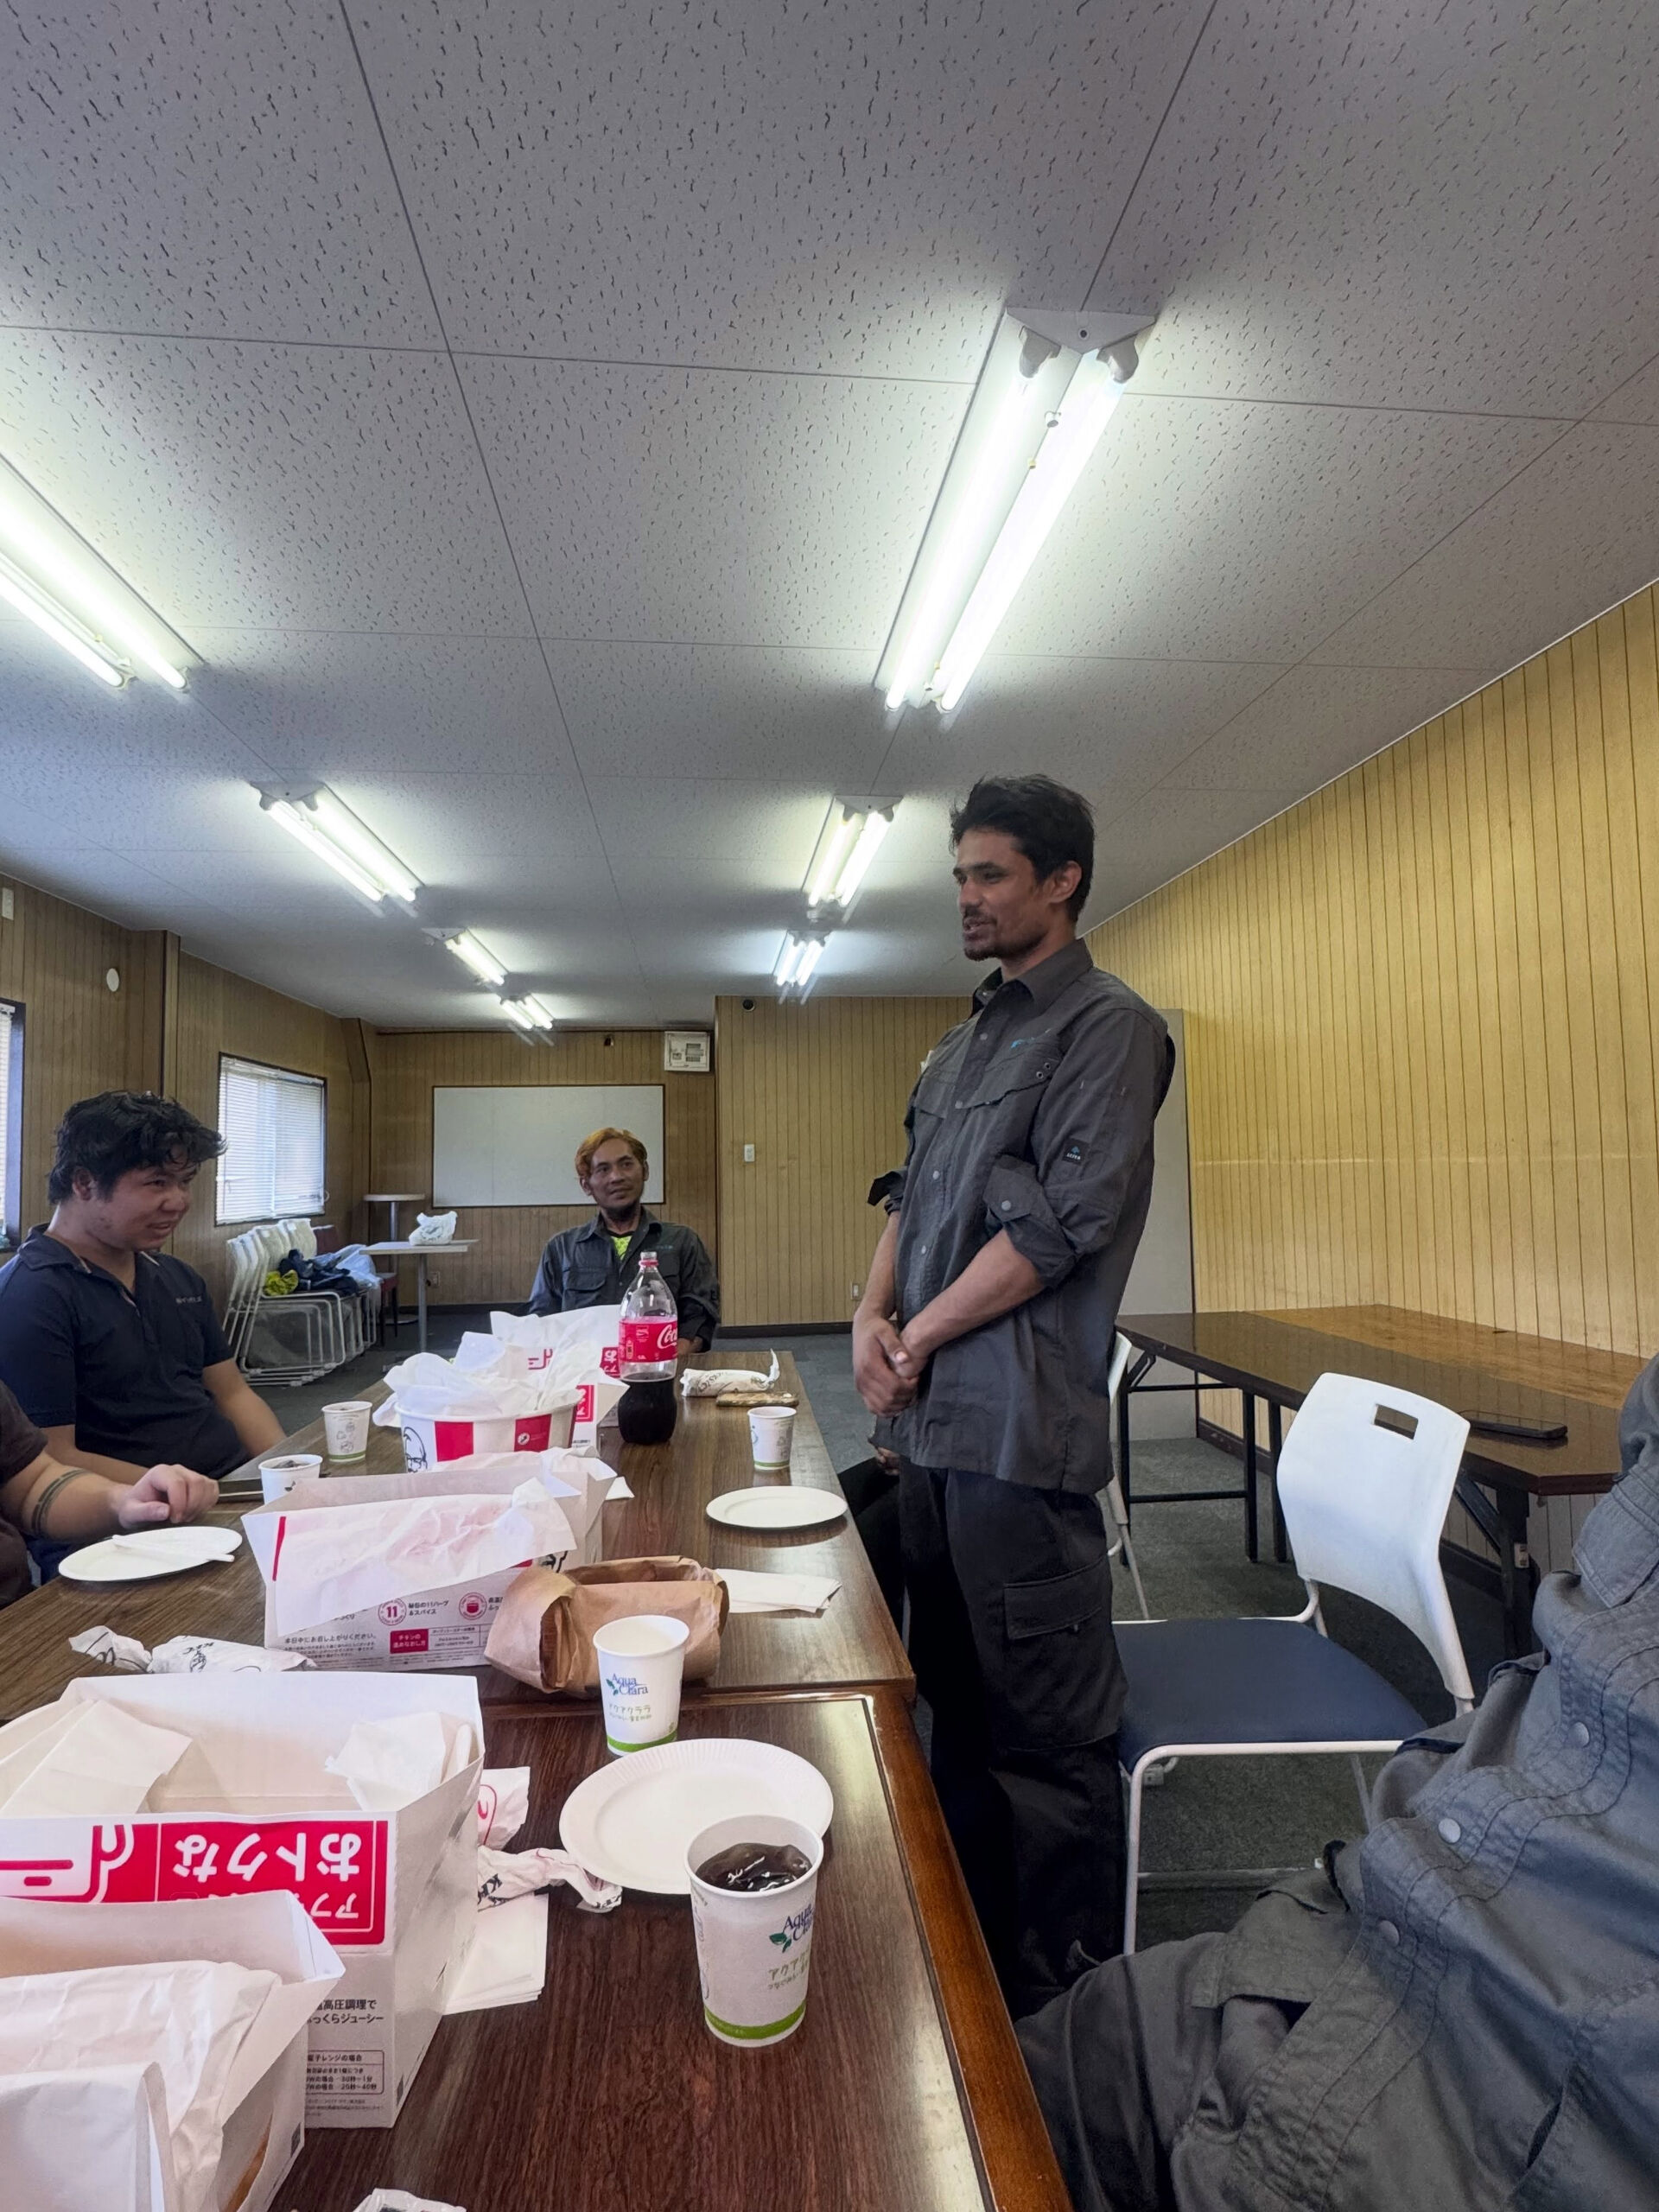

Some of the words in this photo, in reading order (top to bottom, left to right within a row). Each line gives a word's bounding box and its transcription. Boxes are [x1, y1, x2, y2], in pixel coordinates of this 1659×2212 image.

[386, 1605, 397, 1618] 11
[612, 1673, 637, 1687] Aqua
[619, 1684, 649, 1695] Clara
[173, 1833, 362, 1883] おトクな
